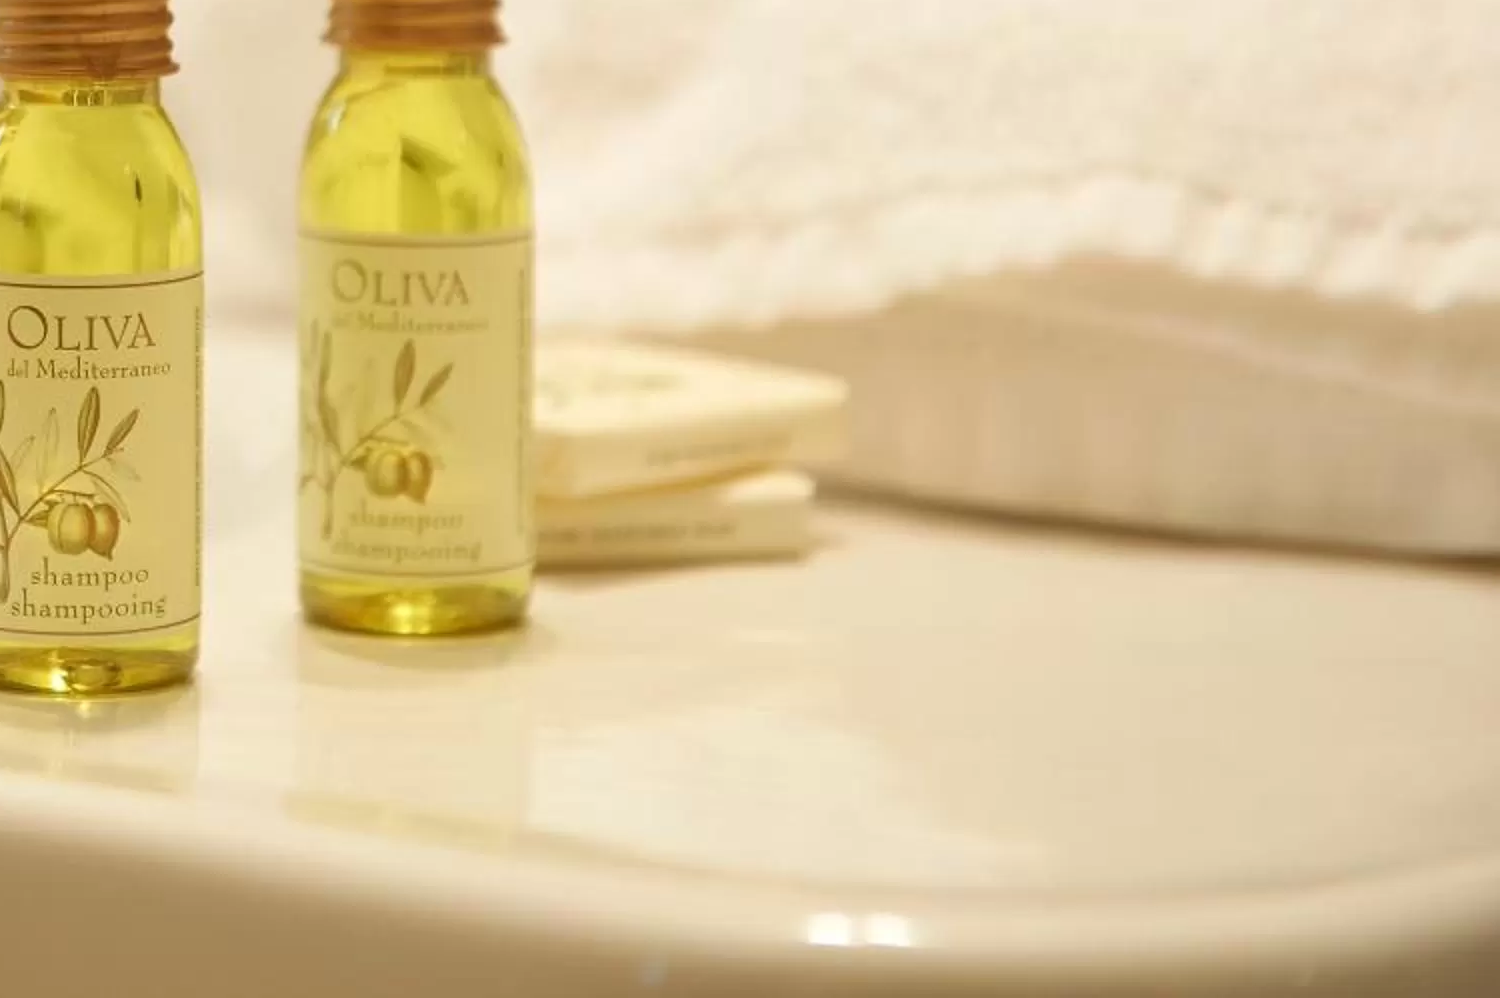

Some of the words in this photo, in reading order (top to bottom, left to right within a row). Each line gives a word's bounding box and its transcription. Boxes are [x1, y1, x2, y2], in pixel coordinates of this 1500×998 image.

[332, 258, 470, 306] OLIVA
[7, 305, 156, 351] OLIVA
[7, 358, 29, 379] del
[36, 355, 172, 380] Mediterraneo
[30, 556, 150, 591] shampoo
[11, 588, 167, 625] shampooing
